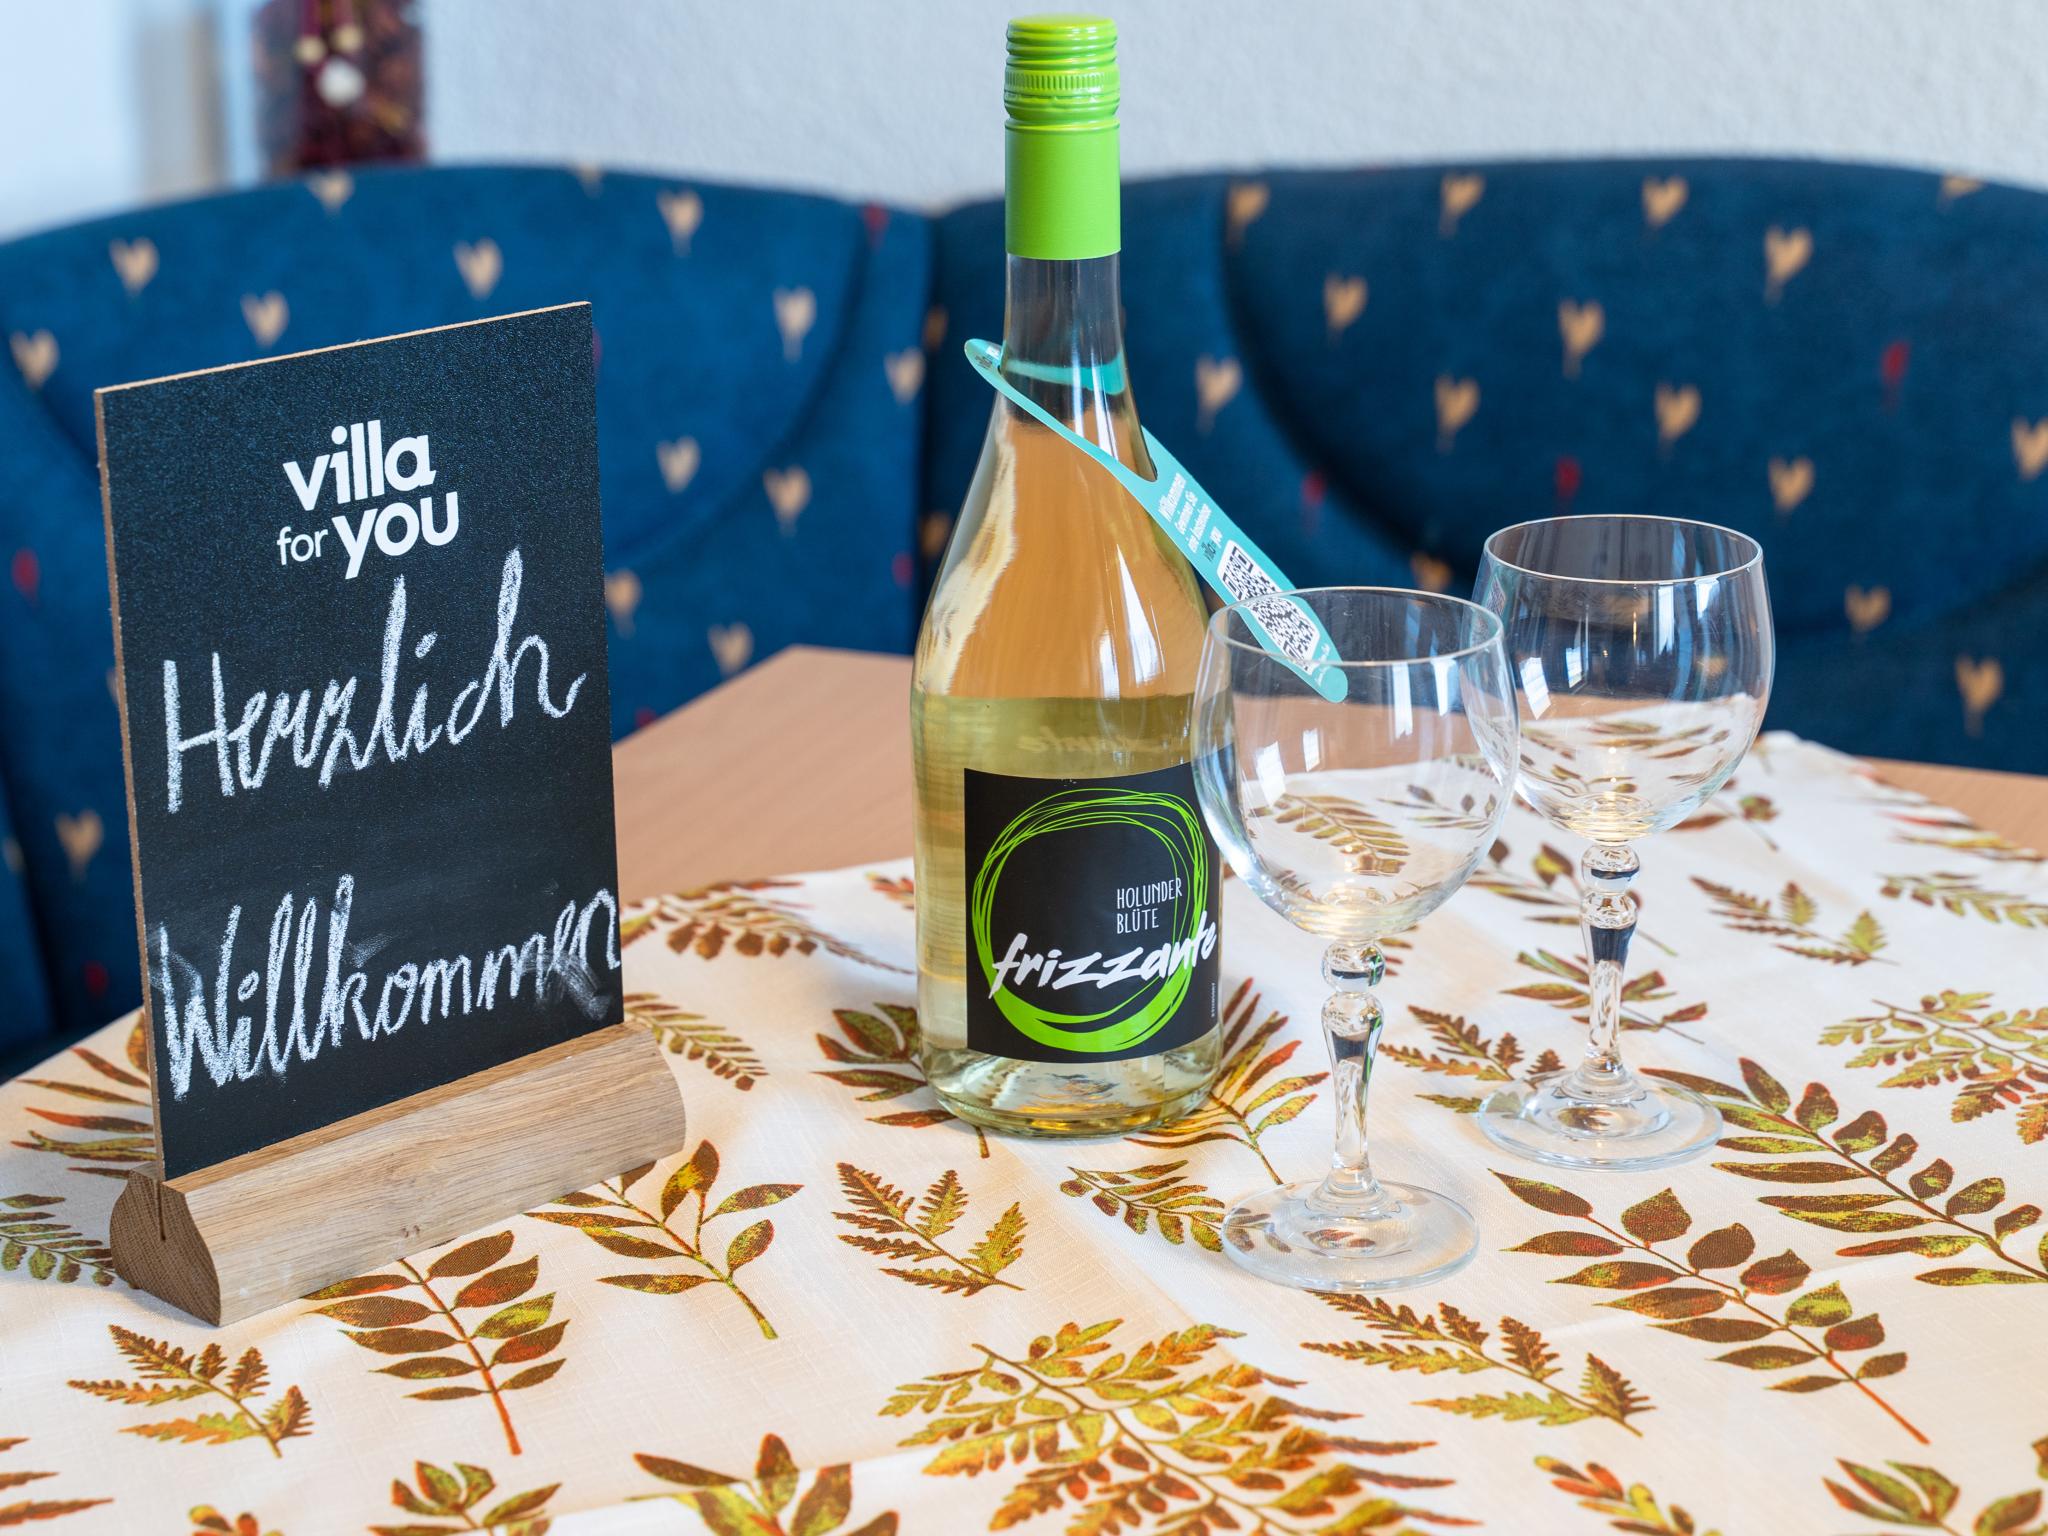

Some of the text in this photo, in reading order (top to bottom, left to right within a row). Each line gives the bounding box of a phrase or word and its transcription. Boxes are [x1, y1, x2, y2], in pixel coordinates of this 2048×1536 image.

[283, 420, 436, 511] villa
[277, 491, 459, 579] for you
[163, 547, 587, 814] Herzlich
[1116, 877, 1183, 910] HOLUNDER
[1116, 908, 1159, 934] BLÜTE
[158, 873, 622, 1101] Willkommen
[988, 911, 1218, 999] frizzante
